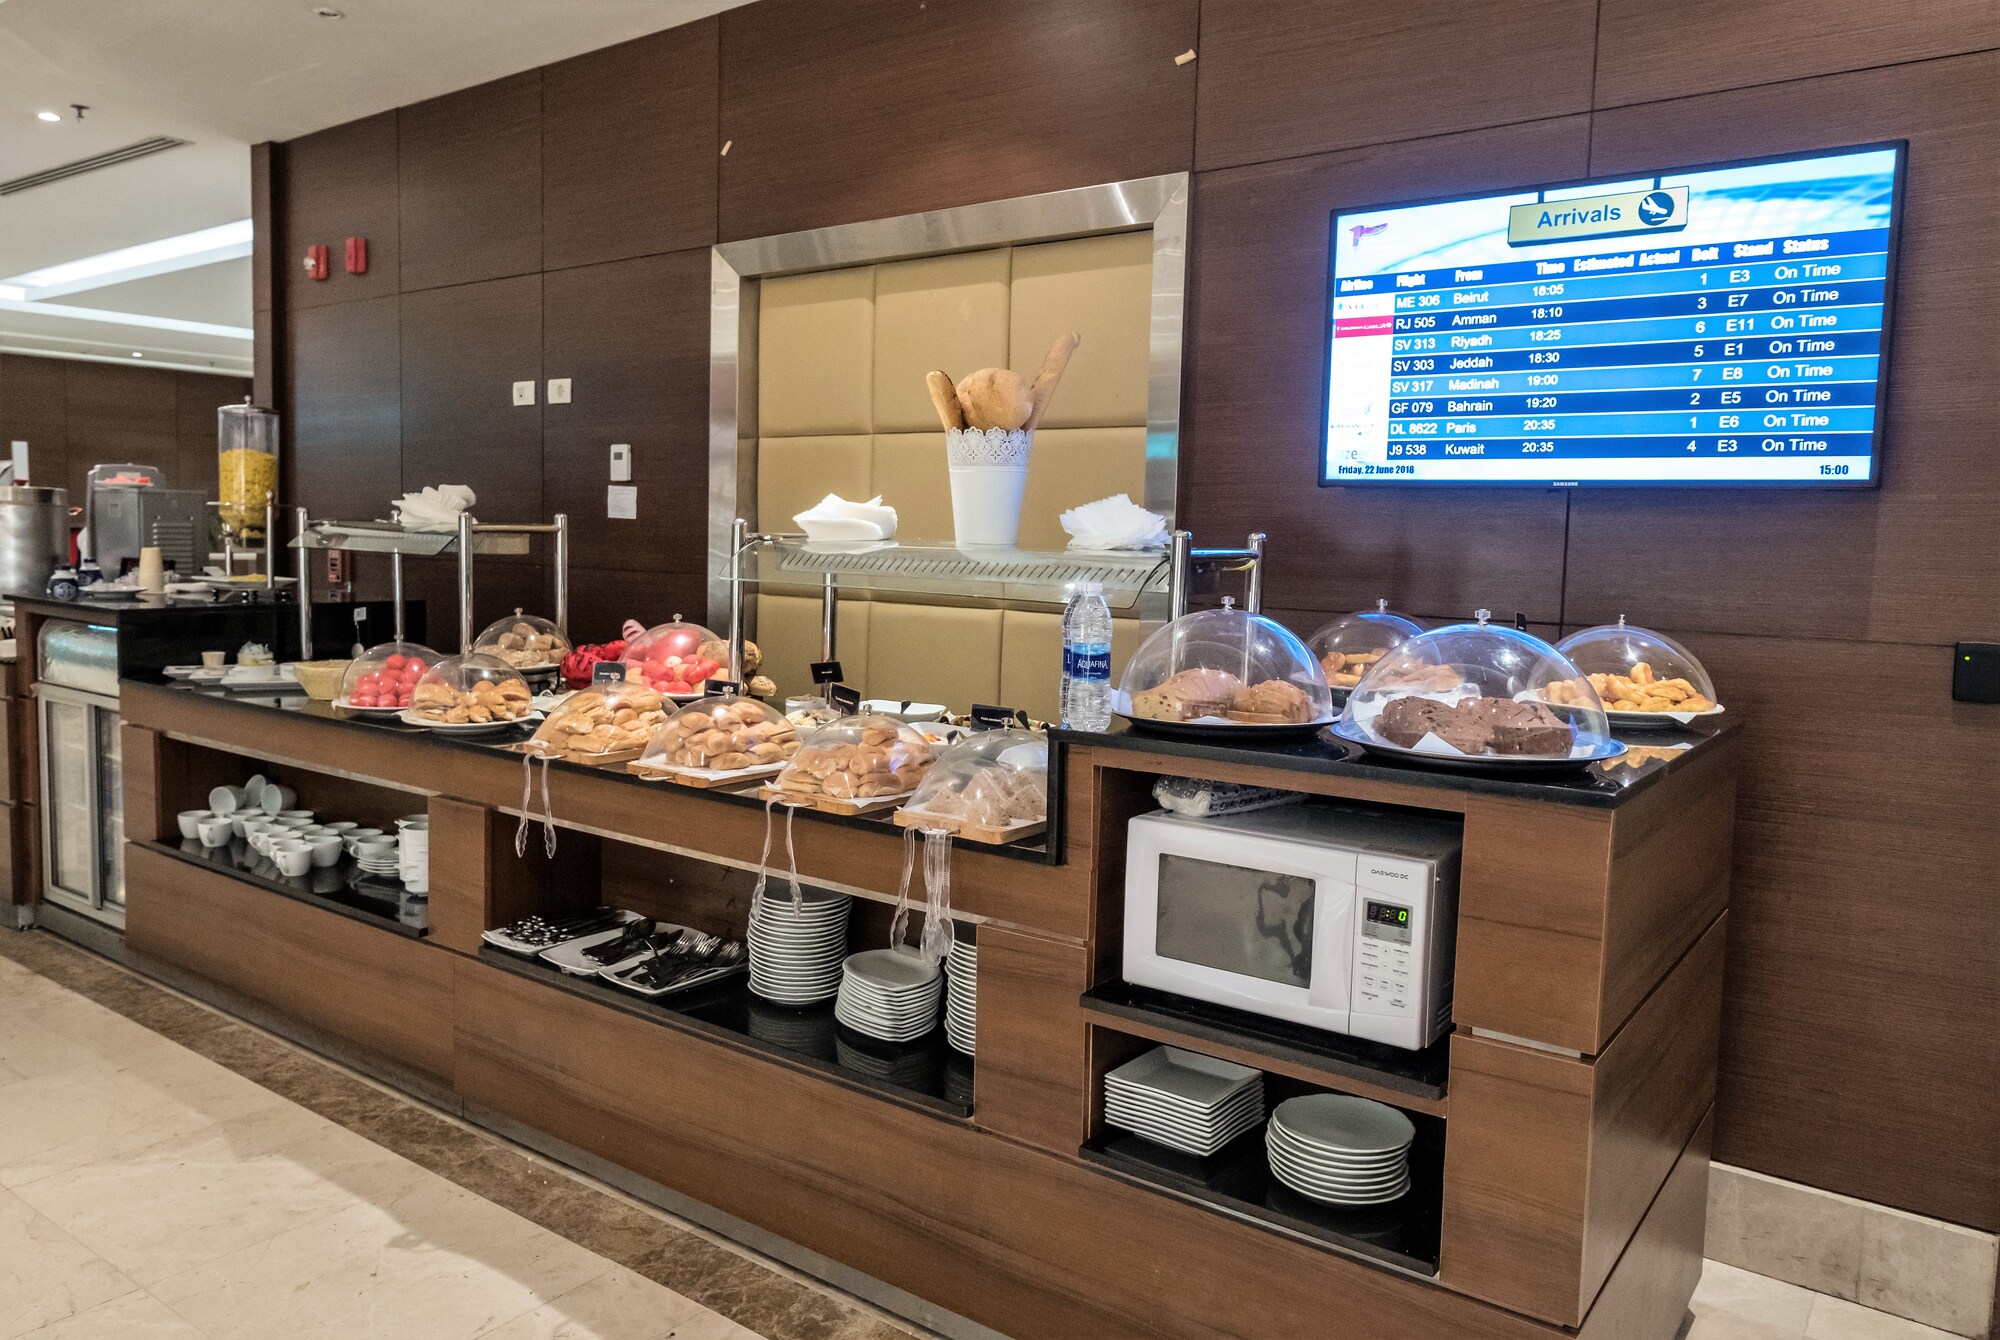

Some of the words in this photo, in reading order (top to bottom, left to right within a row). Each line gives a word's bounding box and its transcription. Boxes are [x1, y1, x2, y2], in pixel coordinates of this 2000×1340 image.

[1537, 204, 1621, 229] Arrivals
[1396, 273, 1426, 288] Flight
[1455, 269, 1483, 282] From
[1536, 262, 1565, 276] Time
[1573, 253, 1635, 273] Estimated
[1638, 250, 1681, 267] Actual
[1733, 241, 1774, 258] Stand
[1783, 238, 1830, 254] Status
[1397, 297, 1415, 308] ME
[1418, 294, 1440, 307] 306
[1453, 291, 1489, 305] Beirut
[1532, 283, 1565, 297] 18:05
[1700, 272, 1707, 285] 1
[1729, 269, 1751, 283] E3
[1774, 266, 1798, 280] On
[1802, 263, 1842, 277] Time
[1395, 318, 1411, 330] RJ
[1414, 316, 1436, 328] 505
[1451, 313, 1497, 327] Amman
[1531, 306, 1563, 319] 18:10
[1697, 296, 1707, 310] 3
[1727, 294, 1749, 308] E7
[1772, 291, 1796, 305] On
[1800, 289, 1839, 303] Time
[1394, 339, 1413, 351] SV
[1414, 337, 1436, 349] 313
[1451, 334, 1493, 350] Riyadh
[1529, 329, 1562, 342] 18:25
[1695, 320, 1706, 334] 6
[1725, 317, 1755, 332] E11
[1770, 315, 1794, 330] On
[1798, 314, 1838, 328] Time
[1393, 360, 1411, 372] SV
[1413, 359, 1435, 371] 303
[1450, 356, 1493, 370] Jeddah
[1528, 352, 1560, 364] 18:30
[1693, 344, 1704, 358] 5
[1724, 342, 1744, 356] E1
[1769, 340, 1792, 354] On
[1796, 338, 1836, 352] Time
[1392, 381, 1410, 393] SV
[1412, 380, 1434, 392] 317
[1448, 378, 1500, 391] Madinah
[1527, 374, 1559, 386] 19:00
[1691, 368, 1703, 382] 7
[1722, 366, 1743, 381] E8
[1766, 364, 1790, 379] On
[1794, 364, 1834, 377] Time
[1391, 402, 1409, 414] GF
[1411, 401, 1434, 413] 079
[1447, 400, 1493, 413] Bahrain
[1526, 397, 1557, 409] 19:20
[1690, 392, 1700, 405] 2
[1720, 390, 1742, 405] E5
[1765, 389, 1789, 403] On
[1792, 388, 1832, 402] Time
[1390, 423, 1406, 435] DL
[1408, 423, 1438, 435] 8622
[1446, 421, 1476, 434] Paris
[1523, 419, 1556, 431] 20:35
[1689, 416, 1697, 429] 1
[1719, 415, 1740, 429] E6
[1763, 413, 1787, 428] On
[1791, 413, 1830, 427] Time
[1389, 444, 1403, 456] J9
[1405, 444, 1427, 456] 538
[1445, 443, 1485, 455] Kuwait
[1521, 441, 1554, 453] 20:35
[1686, 440, 1697, 453] 4
[1717, 438, 1738, 452] E3
[1761, 438, 1785, 452] On
[1789, 438, 1828, 452] Time
[1338, 465, 1364, 475] Friday,
[1365, 465, 1375, 474] 22
[1376, 465, 1394, 474] June
[1395, 465, 1414, 474] 2018
[1819, 464, 1849, 475] 15:00
[1077, 659, 1108, 669] AQUAFINA
[1371, 869, 1399, 878] DAEWOO
